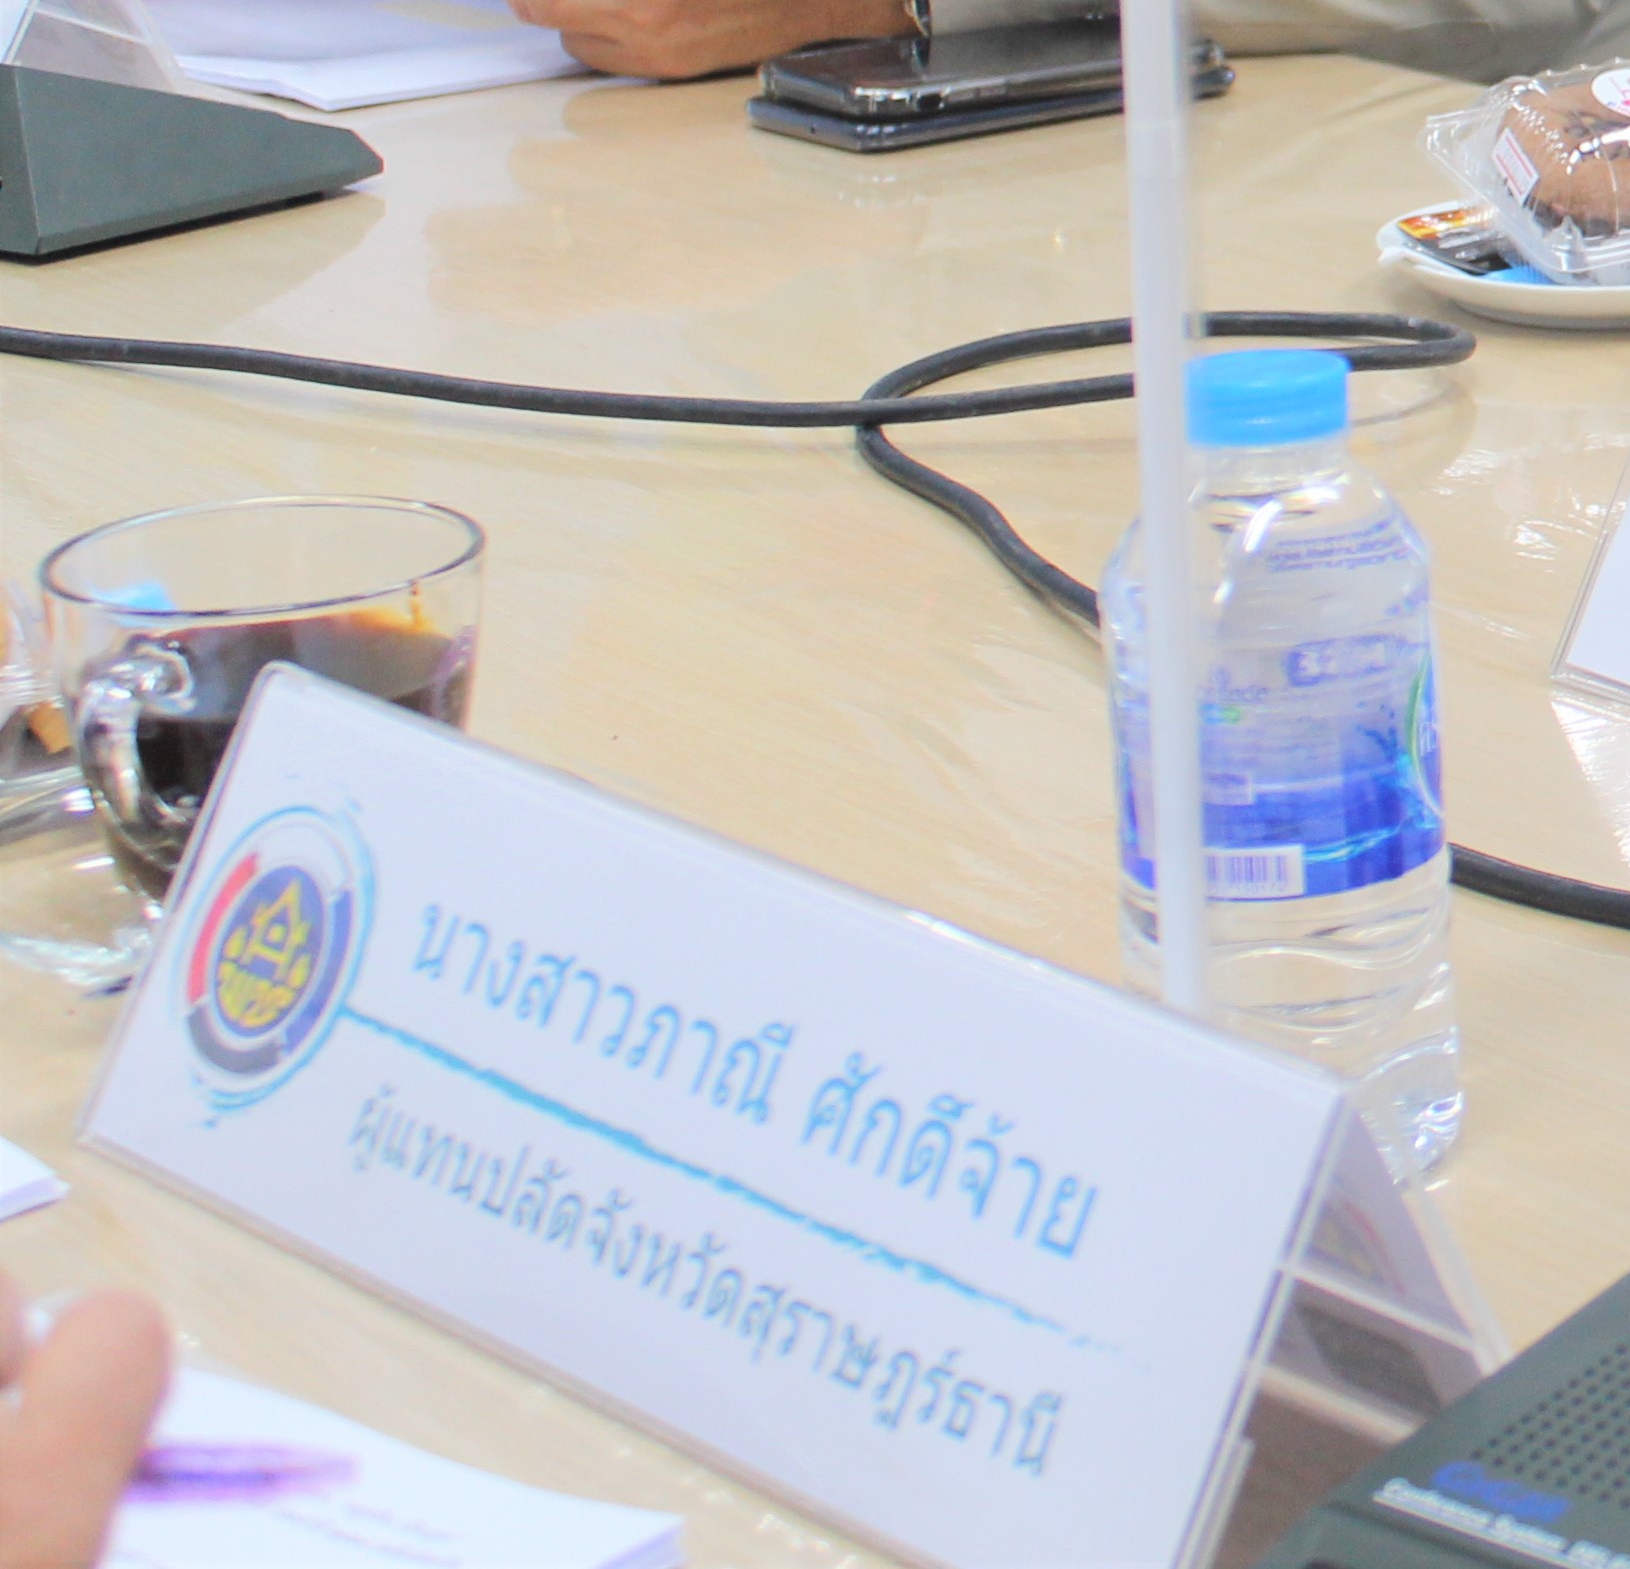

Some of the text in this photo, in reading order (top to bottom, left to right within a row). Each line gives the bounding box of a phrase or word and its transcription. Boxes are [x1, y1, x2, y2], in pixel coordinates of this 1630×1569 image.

[412, 902, 798, 1126] นางสาวภาณี
[349, 1082, 1063, 1477] ผู้แทนปลัดจังหวัดสุราษฎร์ธานี
